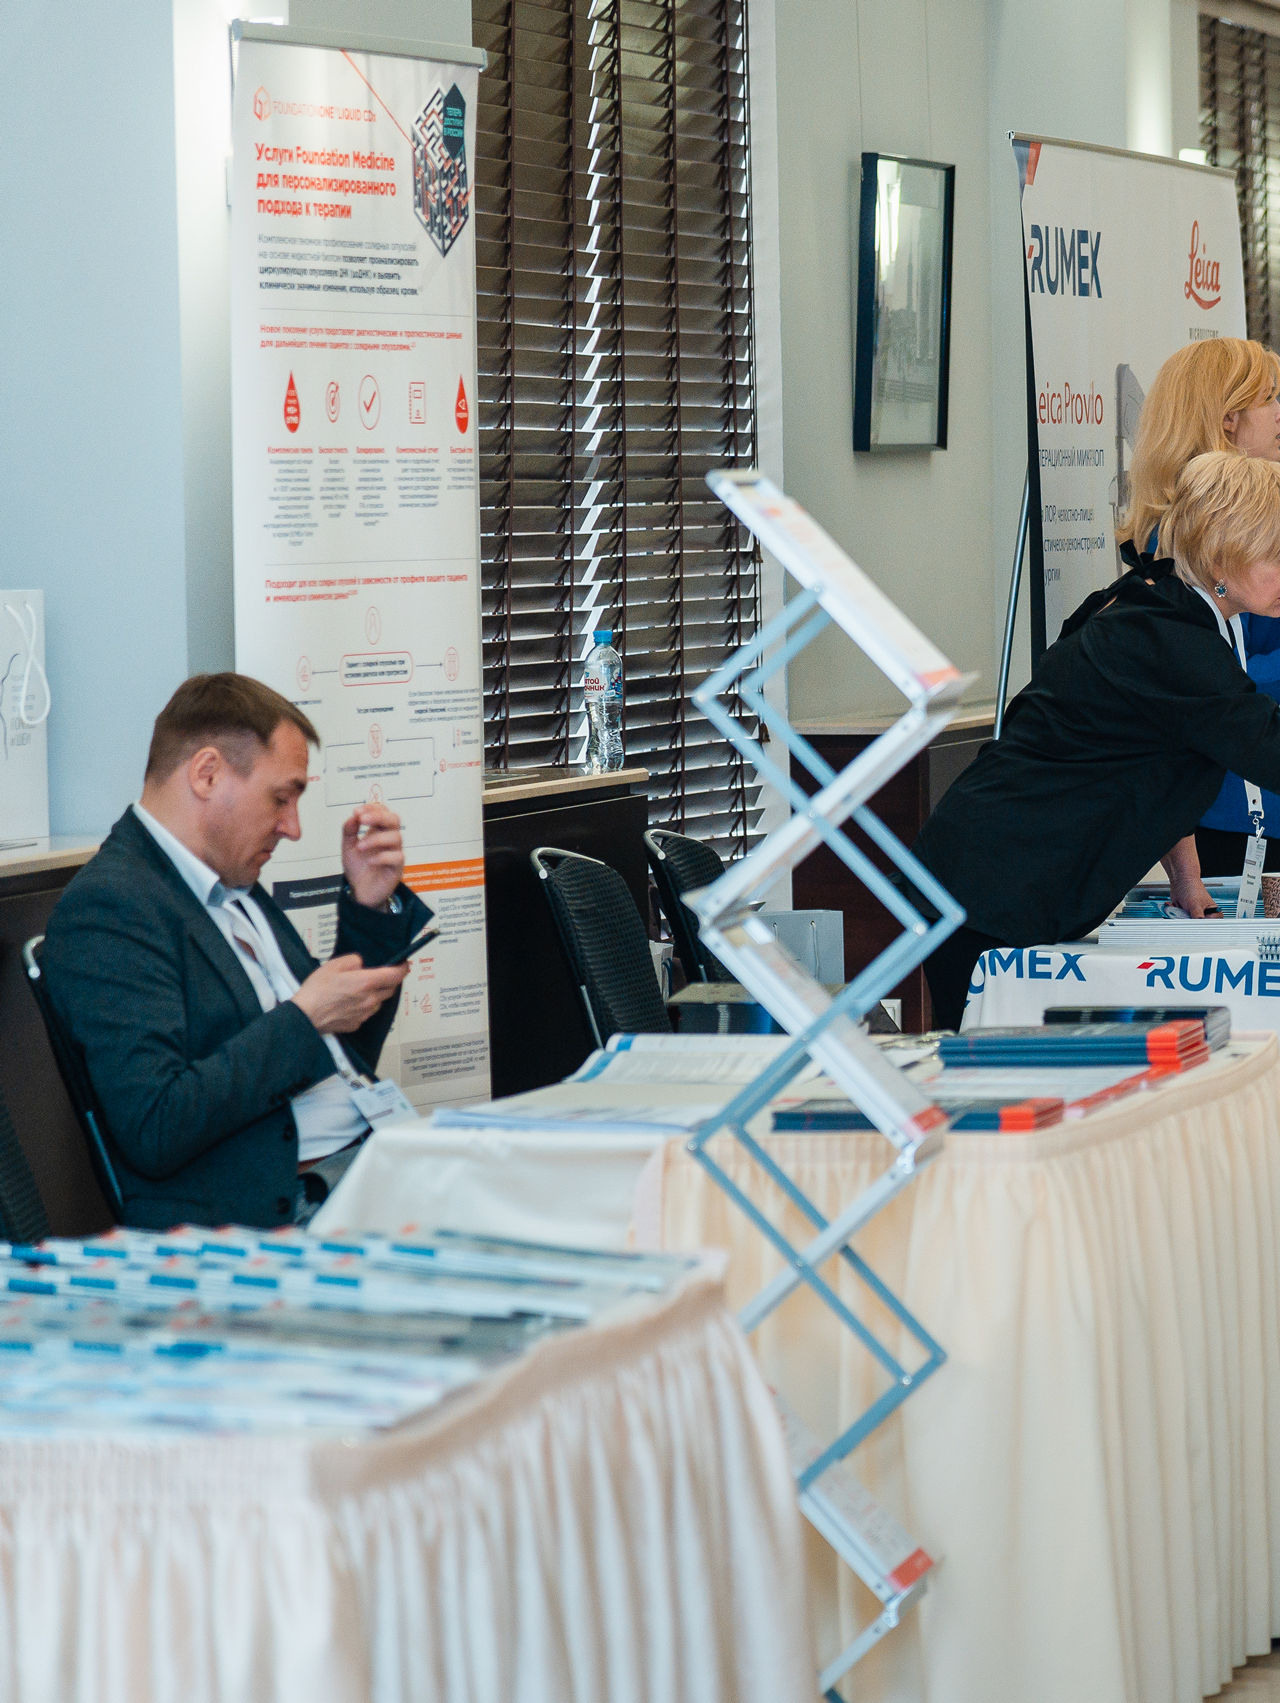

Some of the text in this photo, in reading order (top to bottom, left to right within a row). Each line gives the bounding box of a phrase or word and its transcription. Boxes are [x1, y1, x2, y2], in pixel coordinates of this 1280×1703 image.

[255, 143, 395, 171] Услуги Foundation Medicine
[256, 173, 396, 197] для персонализированного
[257, 199, 352, 219] подхода к терапии
[1028, 224, 1103, 299] RUMEX
[1184, 220, 1221, 310] Leica
[1037, 382, 1063, 425] eica
[968, 948, 1087, 995] UMEX
